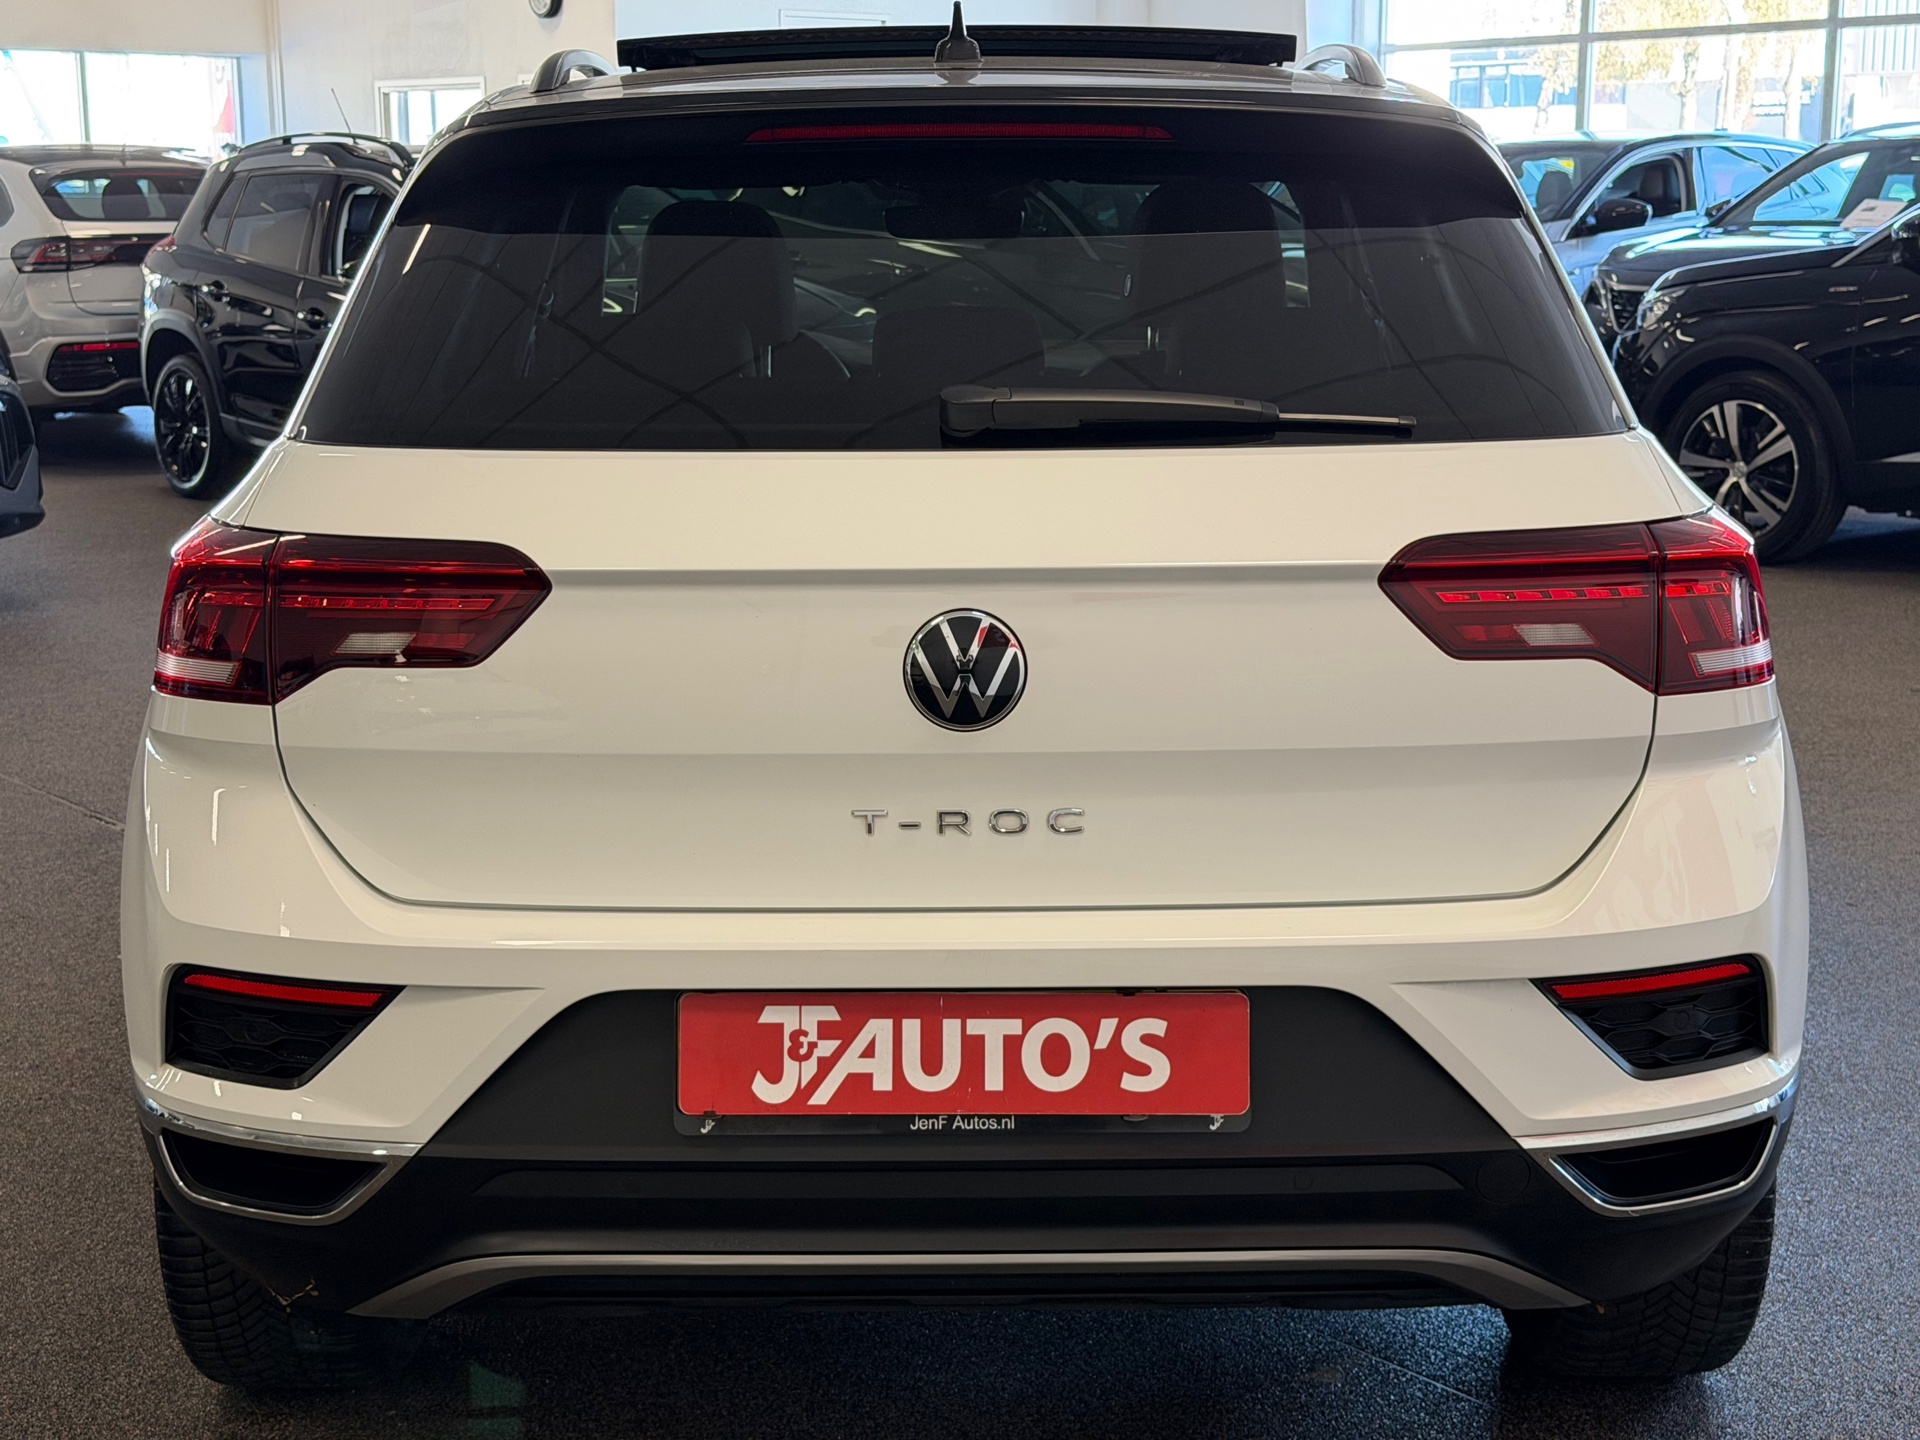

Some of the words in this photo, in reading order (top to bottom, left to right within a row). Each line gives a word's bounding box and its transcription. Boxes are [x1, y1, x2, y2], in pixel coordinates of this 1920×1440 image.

[851, 808, 1085, 836] T-ROC
[910, 1115, 948, 1130] JenF
[952, 1115, 1015, 1130] Autos.nl
